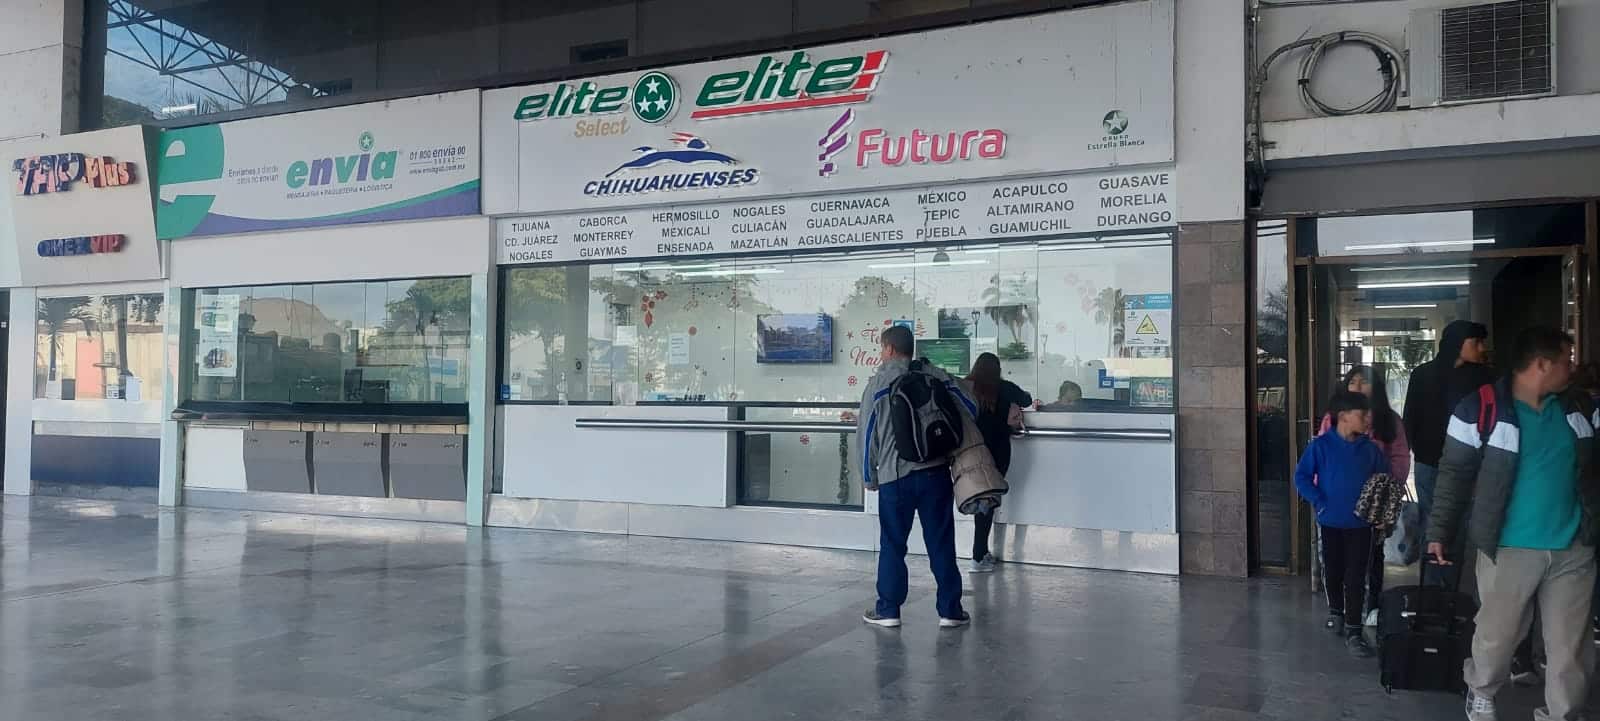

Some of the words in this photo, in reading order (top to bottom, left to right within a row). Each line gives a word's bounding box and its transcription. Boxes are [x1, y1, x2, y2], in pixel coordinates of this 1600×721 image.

[514, 81, 629, 120] elite
[575, 117, 627, 137] Select
[856, 128, 1006, 168] Futura
[1087, 141, 1117, 151] Estrella
[584, 168, 758, 195] CHIHUAHUENSES
[1099, 173, 1169, 190] GUASAVE
[918, 189, 966, 205] MÉXICO
[992, 182, 1068, 199] ACAPULCO
[810, 198, 890, 212] CUERNAVACA
[1100, 192, 1167, 209] MORELIA
[652, 209, 720, 222] HERMOSILLO
[733, 205, 786, 217] NOGALES
[923, 208, 960, 221] TEPIC
[986, 200, 1074, 217] ALTAMIRANO
[579, 216, 628, 228] CABORCA
[806, 214, 894, 229] GUADALAJARA
[1097, 210, 1172, 227] DURANGO
[512, 221, 551, 232] TIJUANA
[662, 226, 711, 238] MEXICALI
[732, 219, 787, 233] CULIACÁN
[916, 225, 967, 239] PUEBLA
[989, 219, 1072, 234] GUAMUCHIL
[504, 238, 520, 248] CD.
[574, 230, 634, 243] MONTERREY
[730, 235, 788, 250] MAZATLÁN
[798, 230, 904, 246] AGUASCALIENTES
[580, 247, 627, 258] GUAYMAS
[657, 241, 714, 253] ENSENADA
[509, 250, 553, 261] NOGALES
